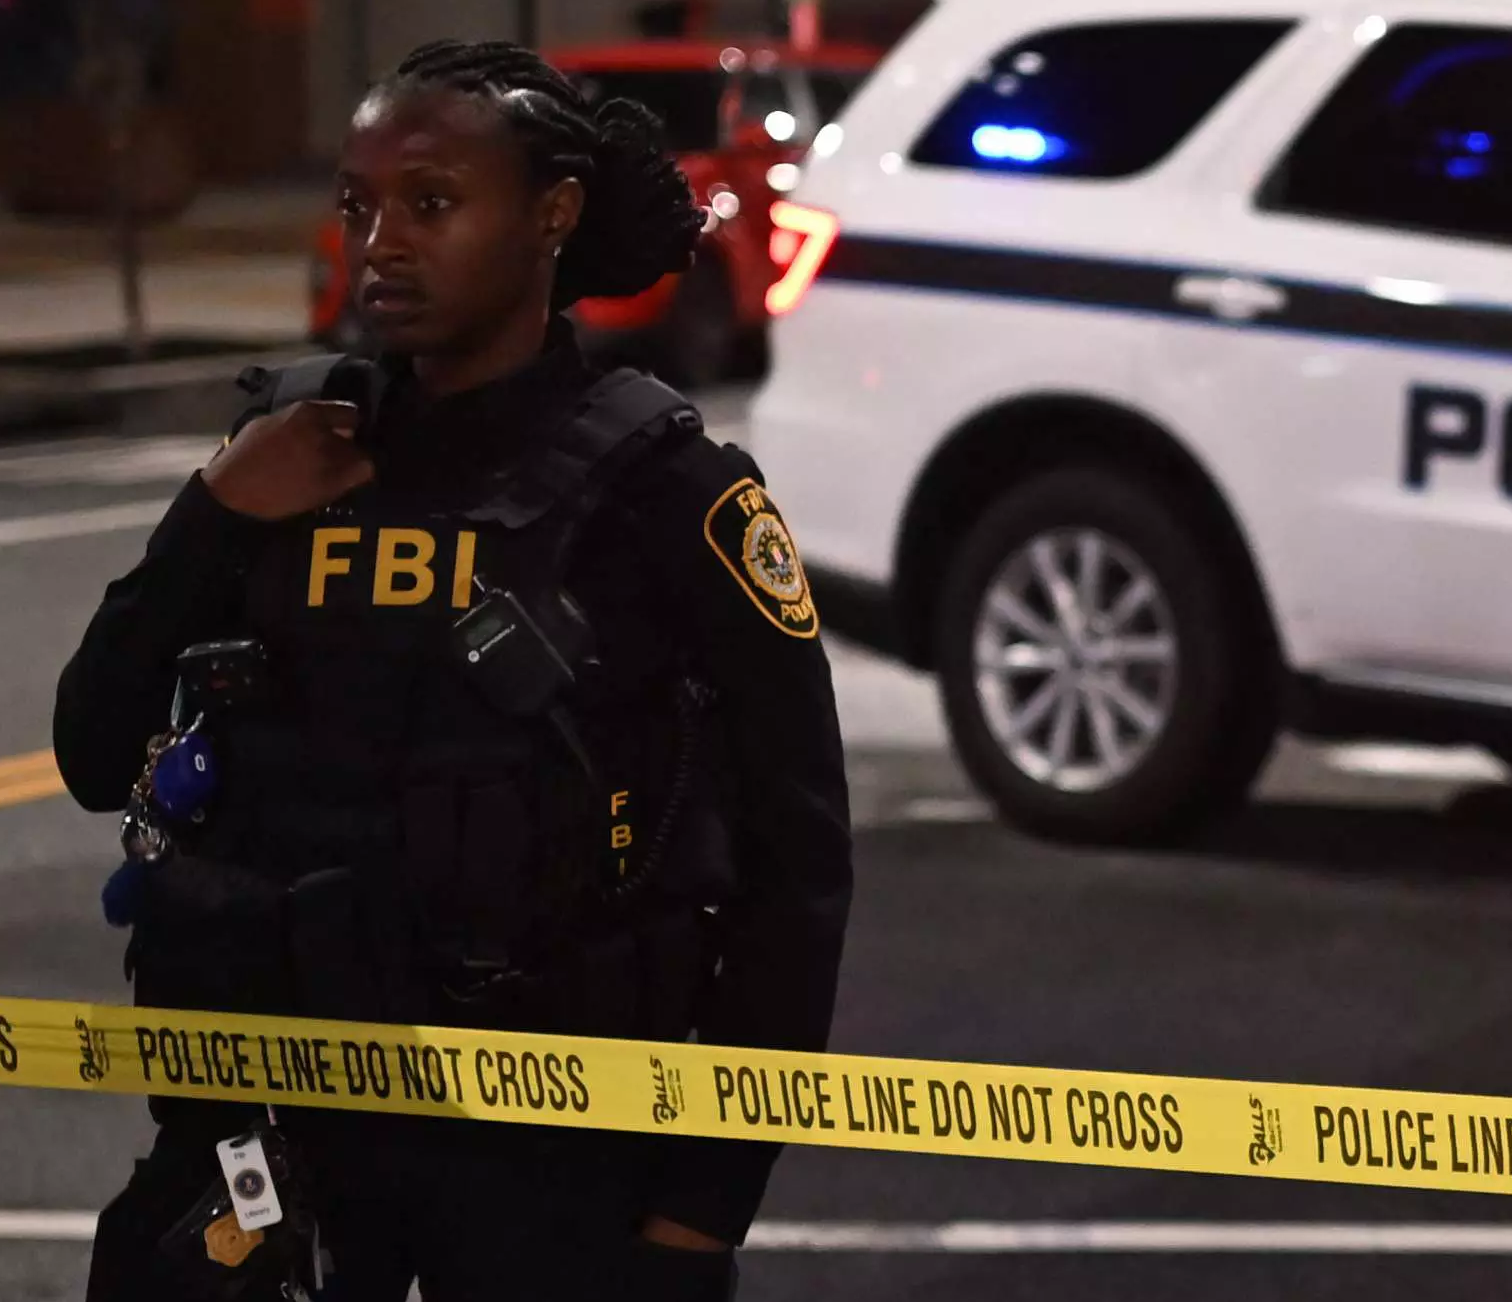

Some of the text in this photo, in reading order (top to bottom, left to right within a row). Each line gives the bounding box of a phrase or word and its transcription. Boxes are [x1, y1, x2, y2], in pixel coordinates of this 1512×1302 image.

[308, 527, 478, 609] FBI
[610, 790, 633, 877] FBI
[134, 1026, 257, 1089] POLICE
[257, 1034, 337, 1095] LINE
[339, 1039, 391, 1100] DO
[396, 1043, 464, 1104] NOT
[474, 1047, 590, 1114] CROSS
[712, 1065, 836, 1130] POLICE
[841, 1074, 921, 1136] LINE
[927, 1079, 977, 1141] DO
[985, 1083, 1053, 1145] NOT
[1066, 1087, 1184, 1154] CROSS
[1313, 1105, 1438, 1171] POLICE
